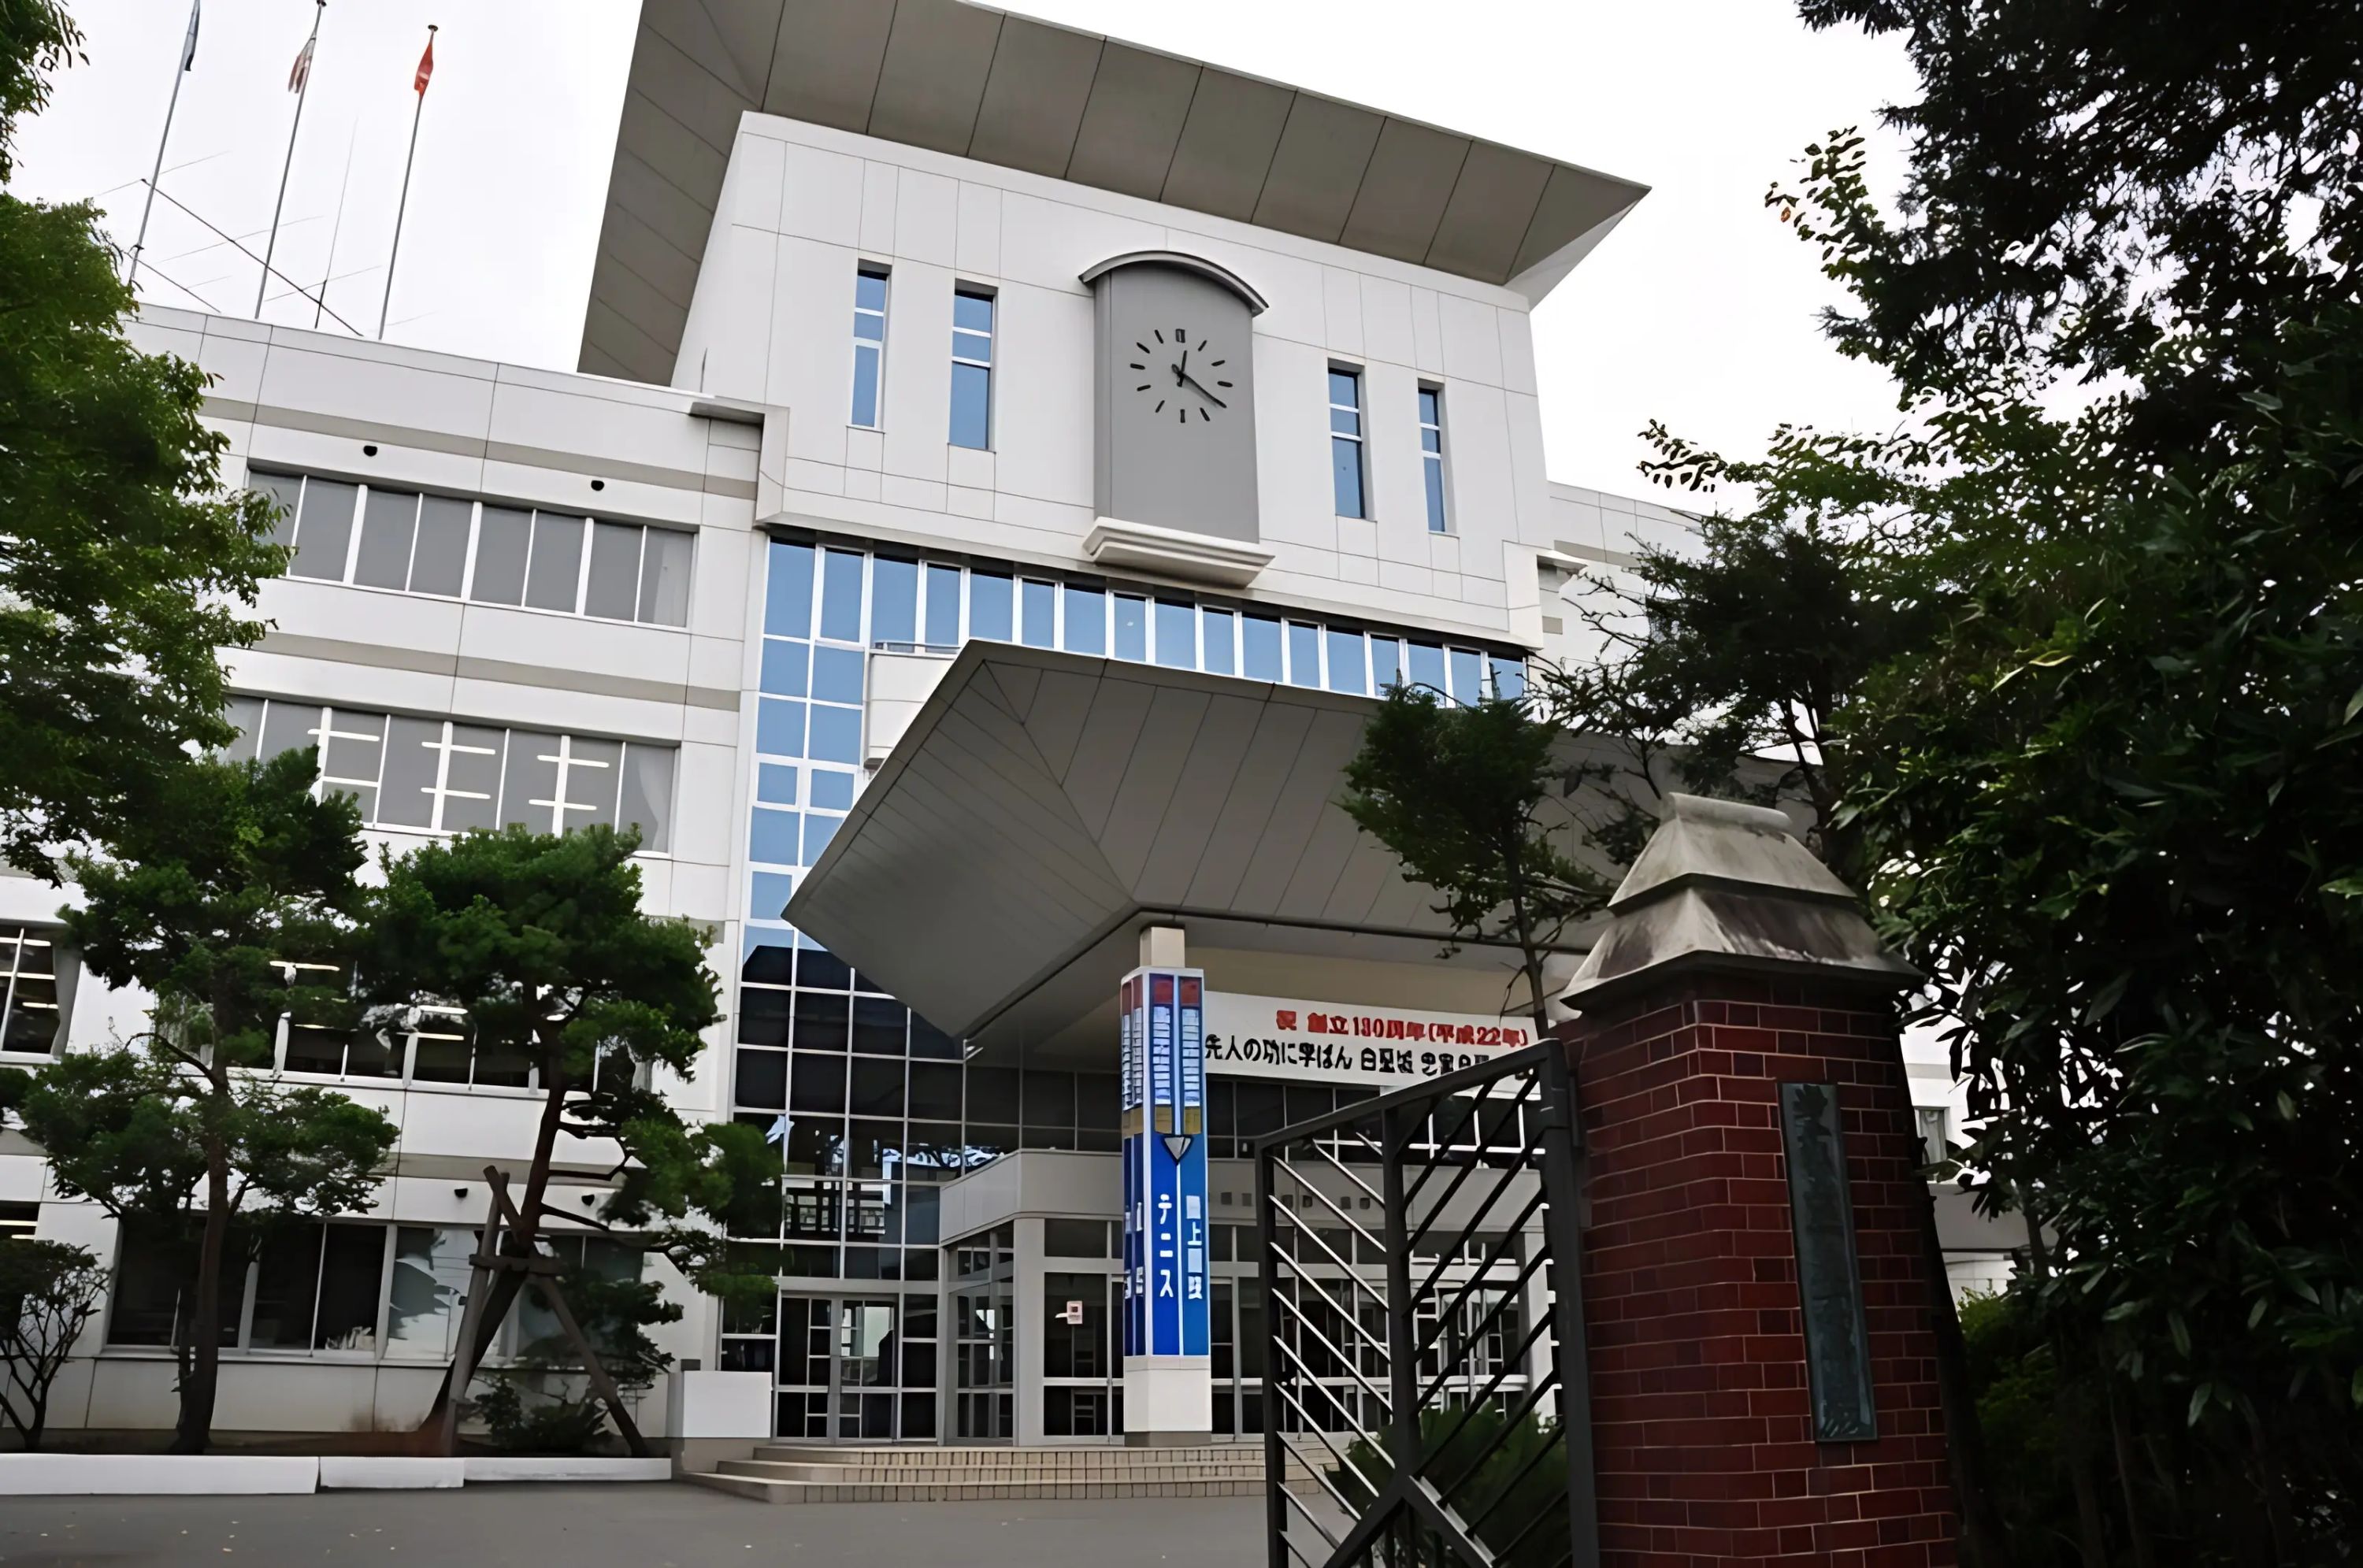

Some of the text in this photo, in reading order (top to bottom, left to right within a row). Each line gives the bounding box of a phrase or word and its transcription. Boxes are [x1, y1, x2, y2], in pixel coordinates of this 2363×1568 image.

[1308, 1012, 1529, 1047] 立130周年(平成22年)
[1158, 1193, 1174, 1299] テニス
